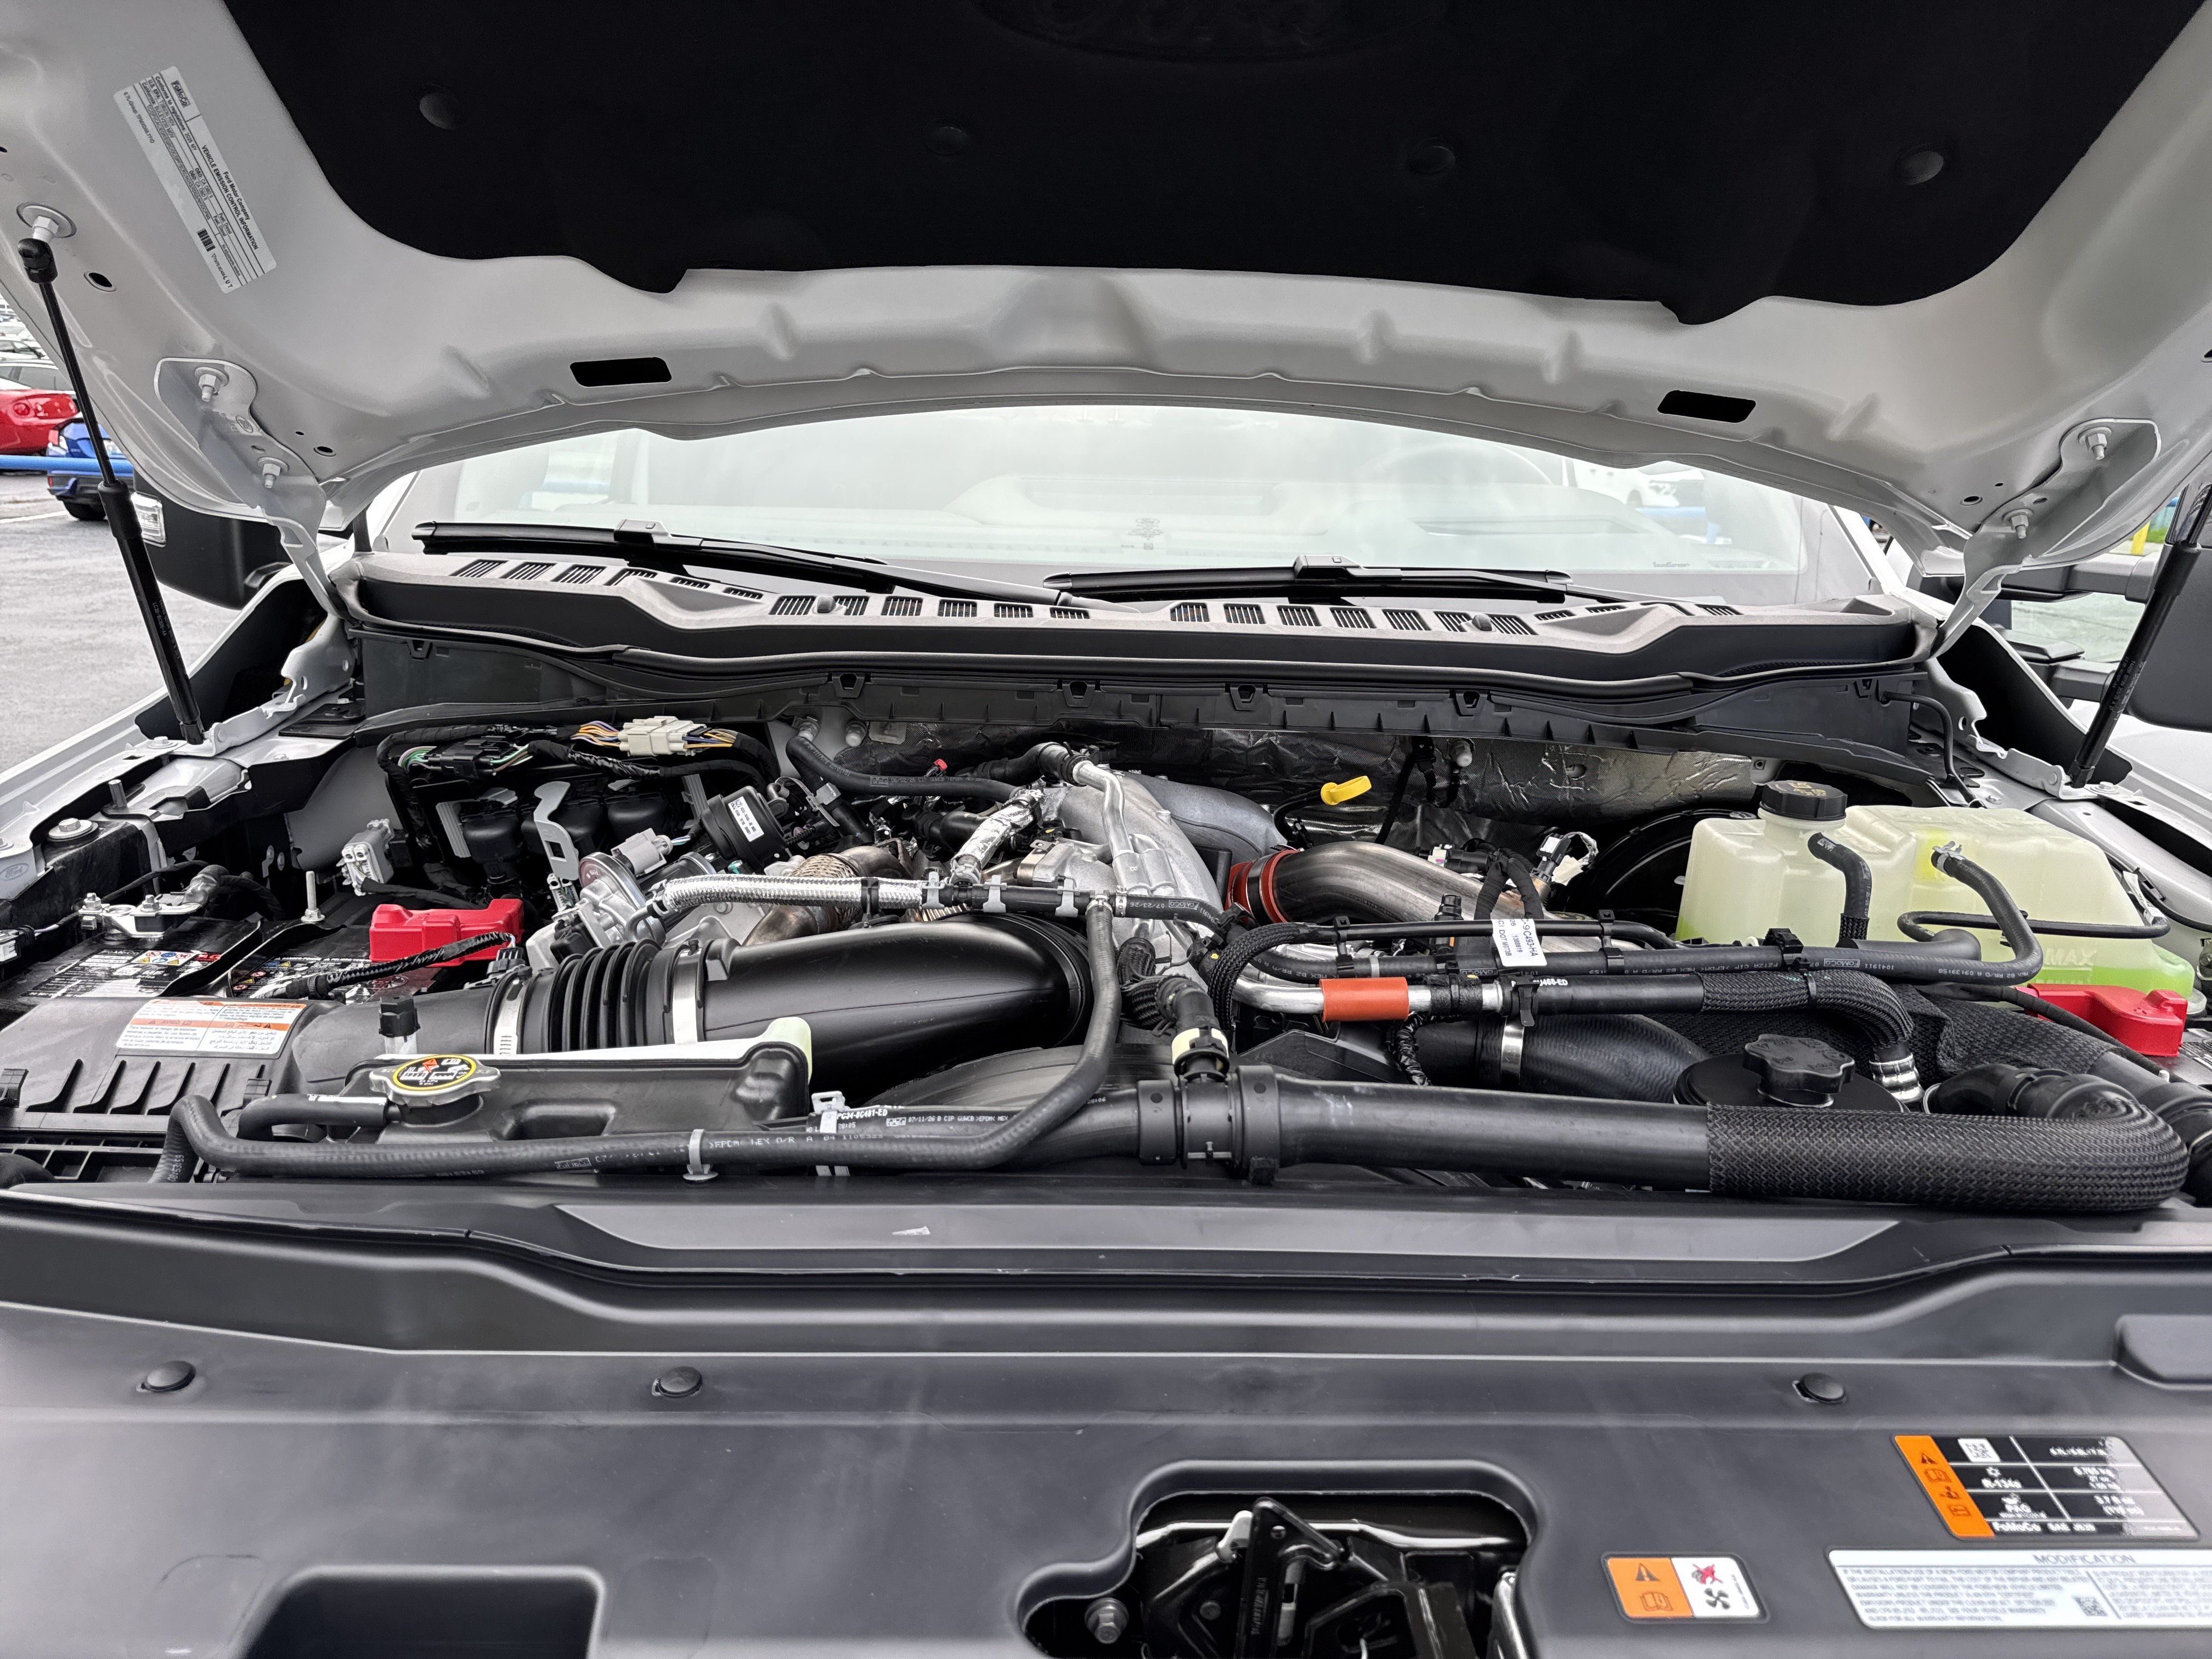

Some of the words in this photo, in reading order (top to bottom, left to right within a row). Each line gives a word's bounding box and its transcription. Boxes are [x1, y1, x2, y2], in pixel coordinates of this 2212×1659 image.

[171, 81, 190, 107] FoMoCo
[201, 144, 217, 168] VEHICLE
[213, 168, 229, 193] EMISSION
[225, 193, 241, 217] CONTROL
[238, 217, 258, 250] INFORMATION
[223, 171, 232, 184] Ford
[229, 183, 240, 198] Motor
[235, 198, 251, 221] Company
[1169, 900, 1198, 910] FoMoCo
[2045, 948, 2097, 966] MAX
[1824, 958, 1860, 967] FoMoCo
[887, 1118, 906, 1126] FoMoCo
[1981, 1478, 2023, 1488] R-134a
[1992, 1522, 2041, 1531] FoMoCo
[2047, 1522, 2071, 1531] SAE
[2033, 1554, 2137, 1565] MODIFICATION
